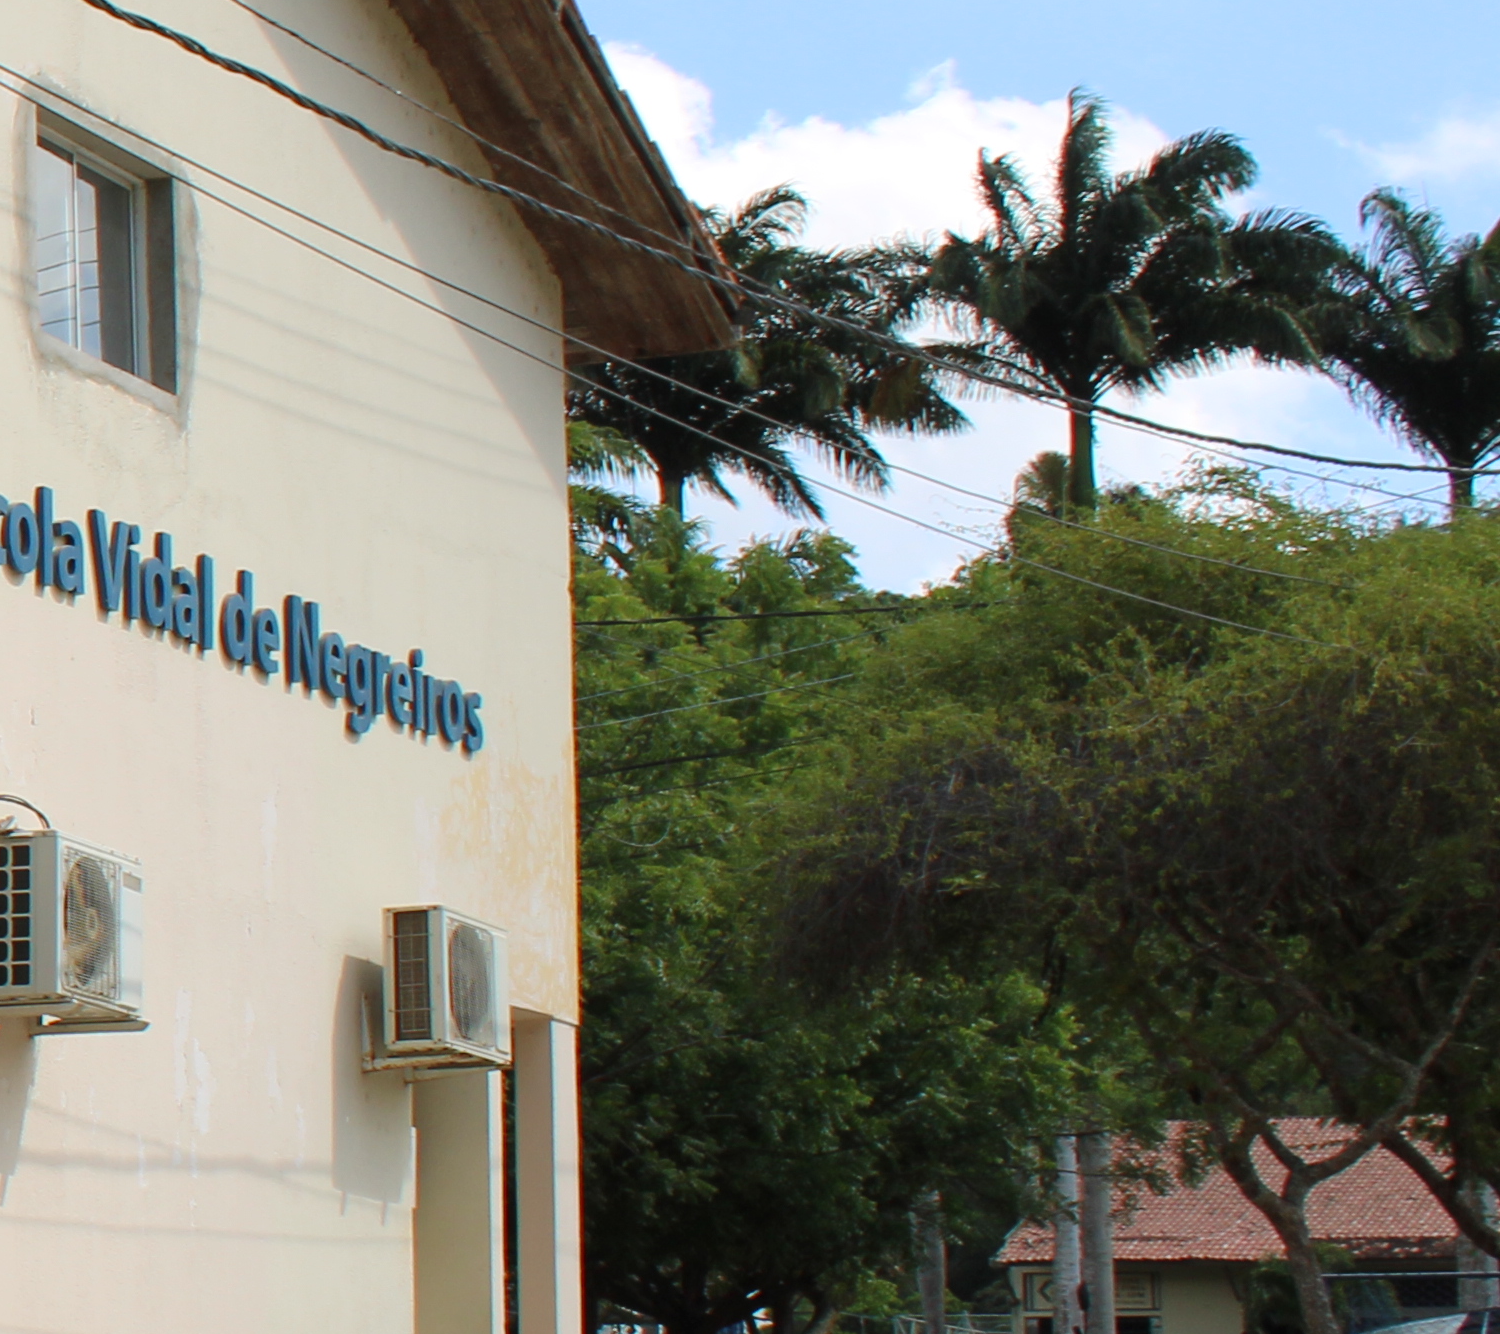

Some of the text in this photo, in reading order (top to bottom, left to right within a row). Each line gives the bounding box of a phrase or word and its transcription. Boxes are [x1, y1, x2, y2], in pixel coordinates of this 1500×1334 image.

[87, 508, 214, 651] Vidal
[220, 569, 280, 673] de
[283, 593, 484, 752] Negreiros
